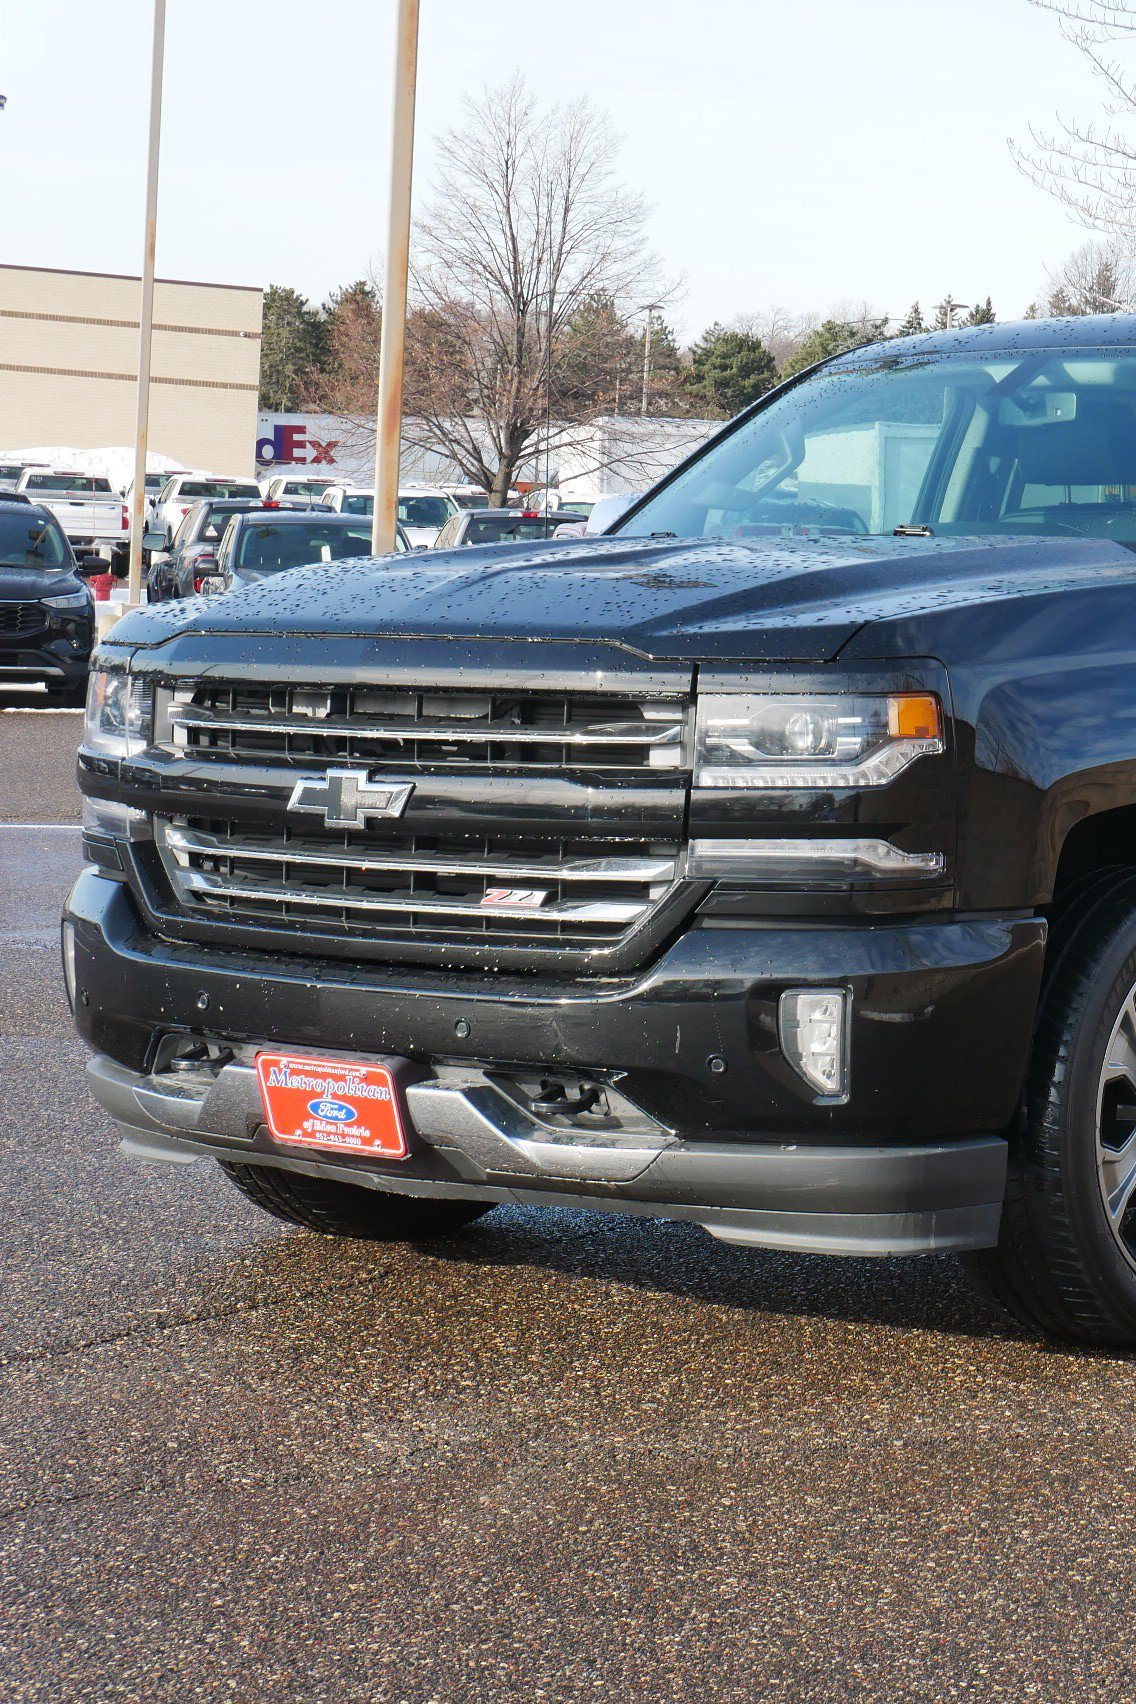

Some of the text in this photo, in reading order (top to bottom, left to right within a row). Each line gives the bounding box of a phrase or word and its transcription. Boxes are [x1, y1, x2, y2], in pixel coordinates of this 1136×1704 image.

[255, 424, 340, 467] dEx
[481, 888, 547, 907] Z71
[268, 1066, 391, 1100] Metropolitan
[318, 1102, 347, 1119] Ford
[303, 1119, 370, 1137] of Eden Prairie
